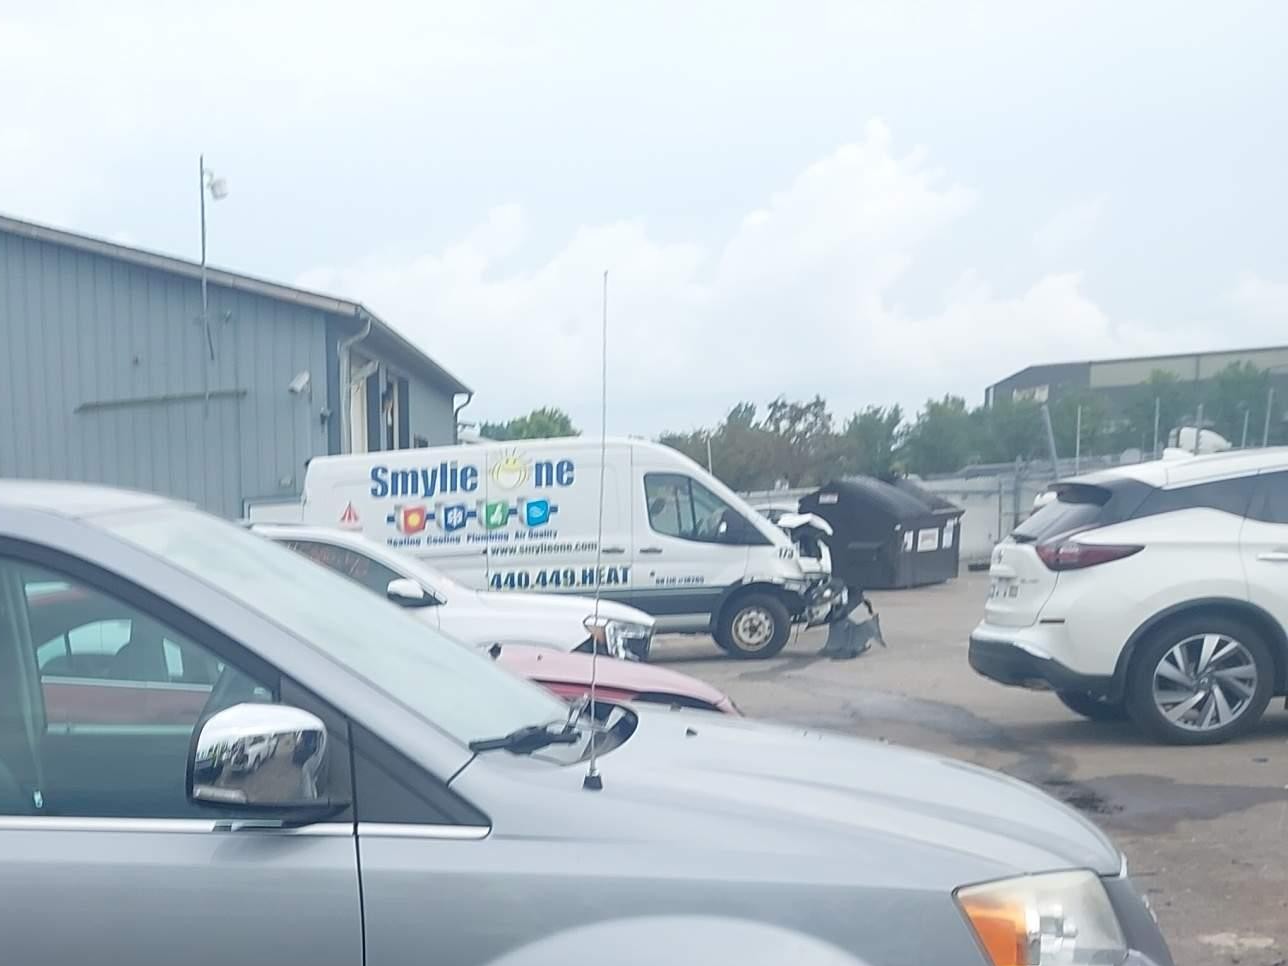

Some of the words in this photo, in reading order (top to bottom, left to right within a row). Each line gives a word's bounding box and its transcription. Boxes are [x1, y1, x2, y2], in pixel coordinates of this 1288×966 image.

[370, 461, 478, 498] Smylie
[426, 535, 461, 545] Cooling
[467, 532, 509, 543] Plumbing
[514, 531, 527, 539] Air
[528, 529, 558, 540] Quality
[490, 542, 598, 556] www.smylieone.com
[490, 566, 630, 590] 440.449.HEAT
